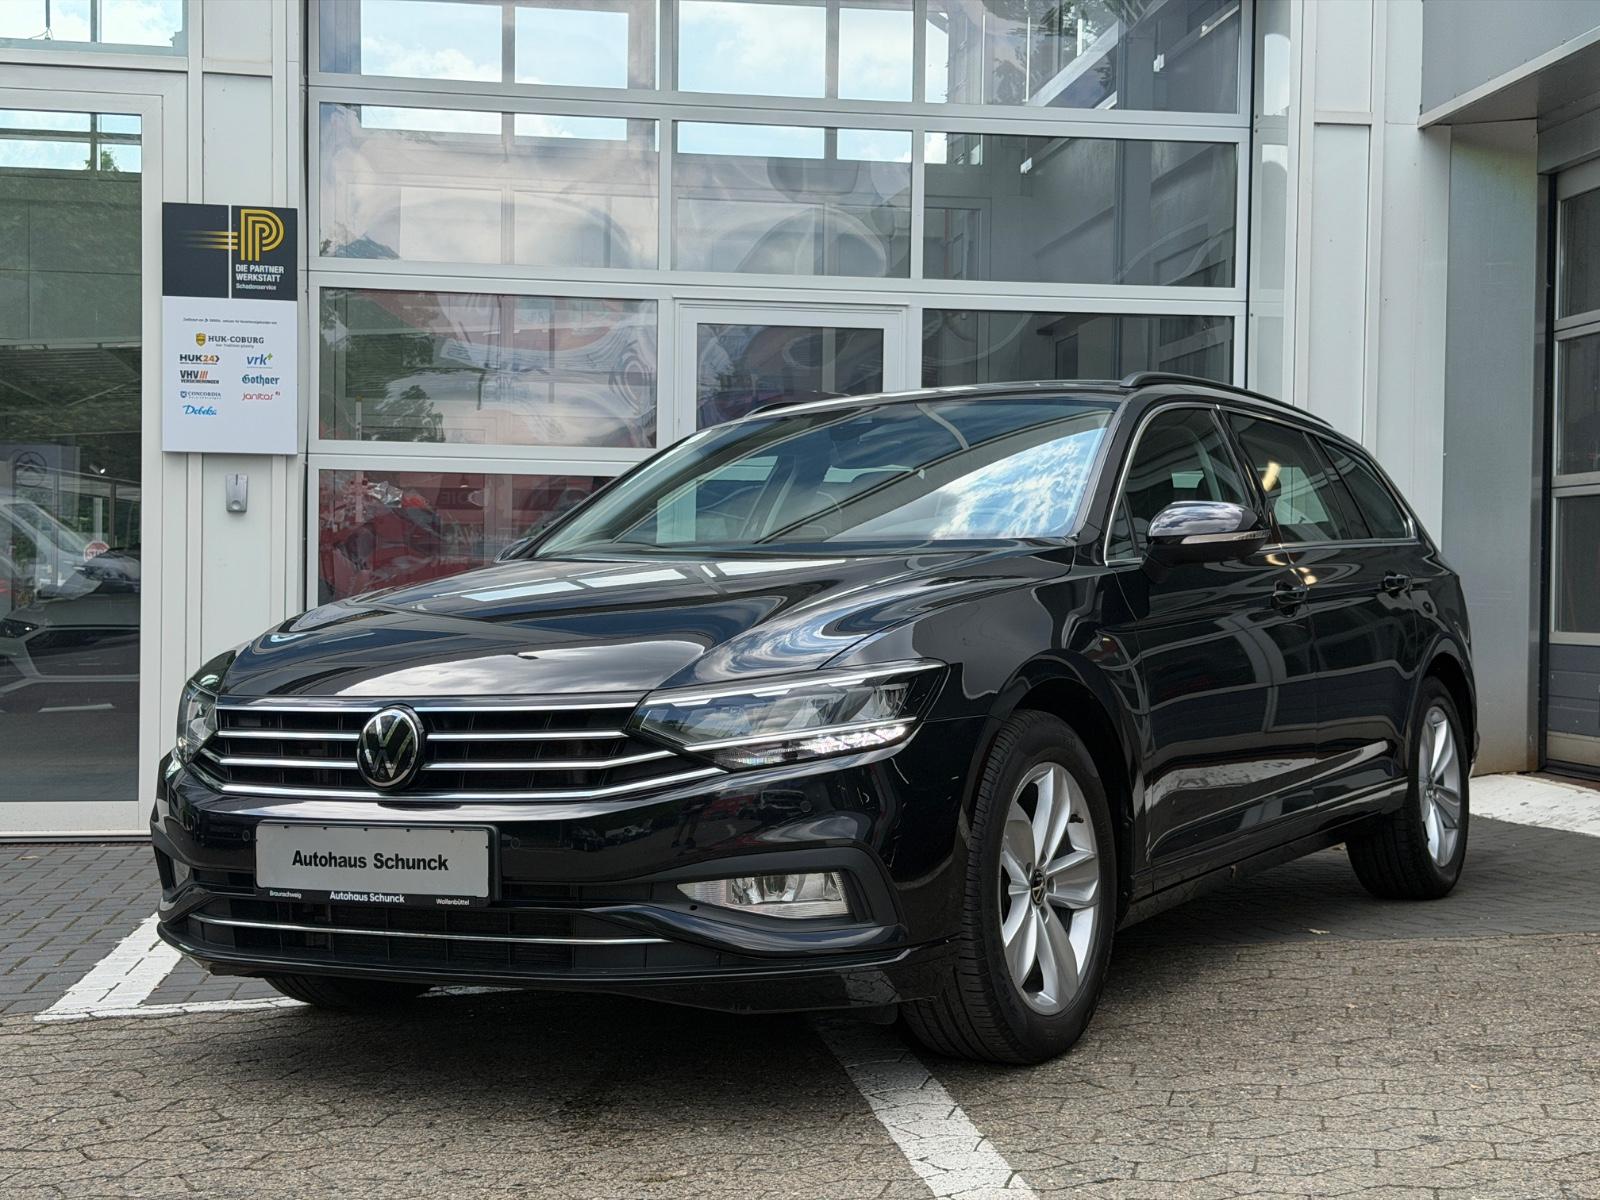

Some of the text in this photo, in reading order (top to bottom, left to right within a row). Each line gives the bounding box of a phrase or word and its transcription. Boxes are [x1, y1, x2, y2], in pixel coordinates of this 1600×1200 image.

[235, 264, 285, 274] DIE PARTNER
[235, 273, 281, 282] WERKSTATT
[208, 336, 264, 344] HUK-COBURG
[180, 370, 199, 379] VHV
[242, 374, 280, 386] Gothaer
[292, 850, 449, 871] Autohaus Schunck
[269, 890, 302, 900] Braunschweig
[329, 891, 369, 902] Autohaus
[369, 892, 405, 904] Schunck
